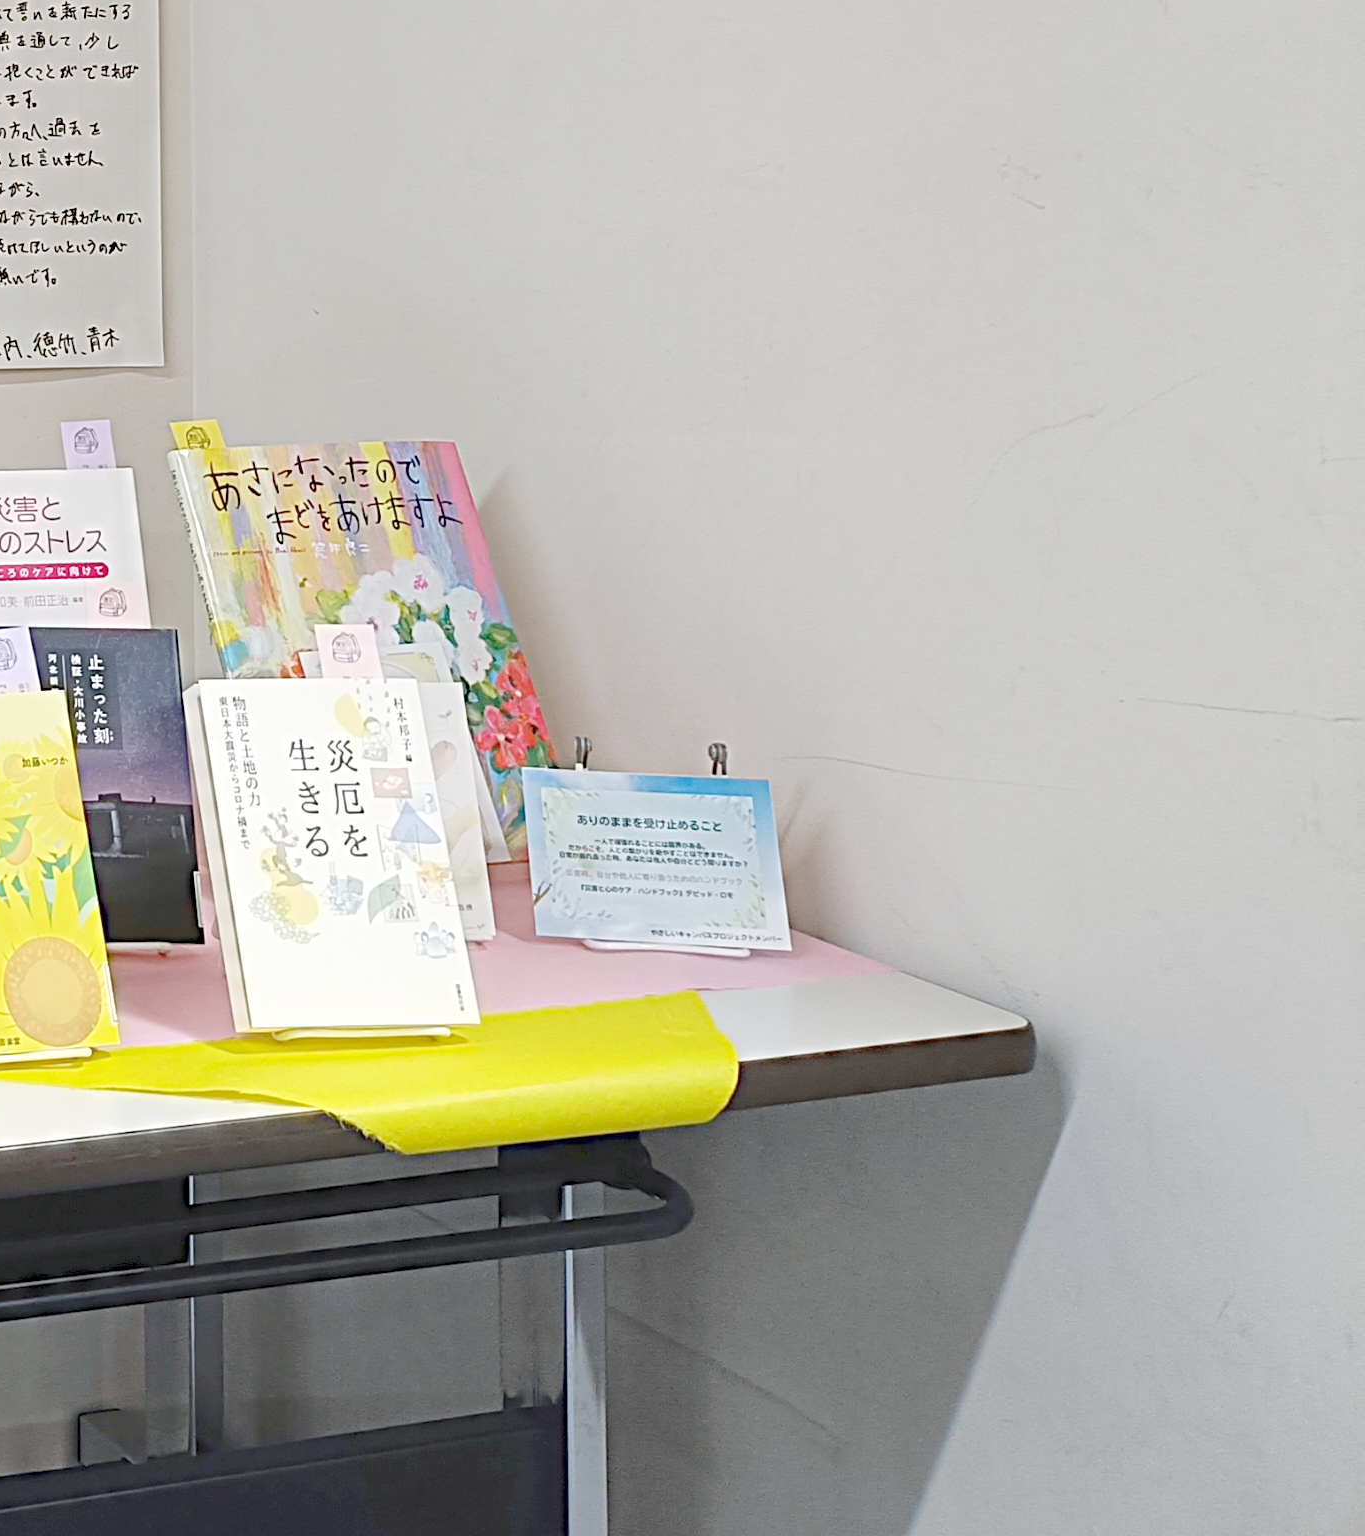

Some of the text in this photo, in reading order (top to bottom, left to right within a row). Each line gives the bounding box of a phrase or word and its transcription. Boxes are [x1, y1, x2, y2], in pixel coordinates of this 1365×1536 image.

[204, 455, 421, 512] あさになったので
[267, 493, 463, 545] まどをあけますよ
[71, 654, 87, 745] 検証・大川小事故
[88, 653, 112, 745] 止まった刻
[393, 697, 412, 751] 村本邦子
[22, 756, 68, 768] 加藤いつか
[233, 696, 260, 807] 物語と土地の力
[288, 739, 330, 858] 生きる
[327, 739, 369, 858] 災厄を
[577, 815, 722, 832] ありのままを受け止めること
